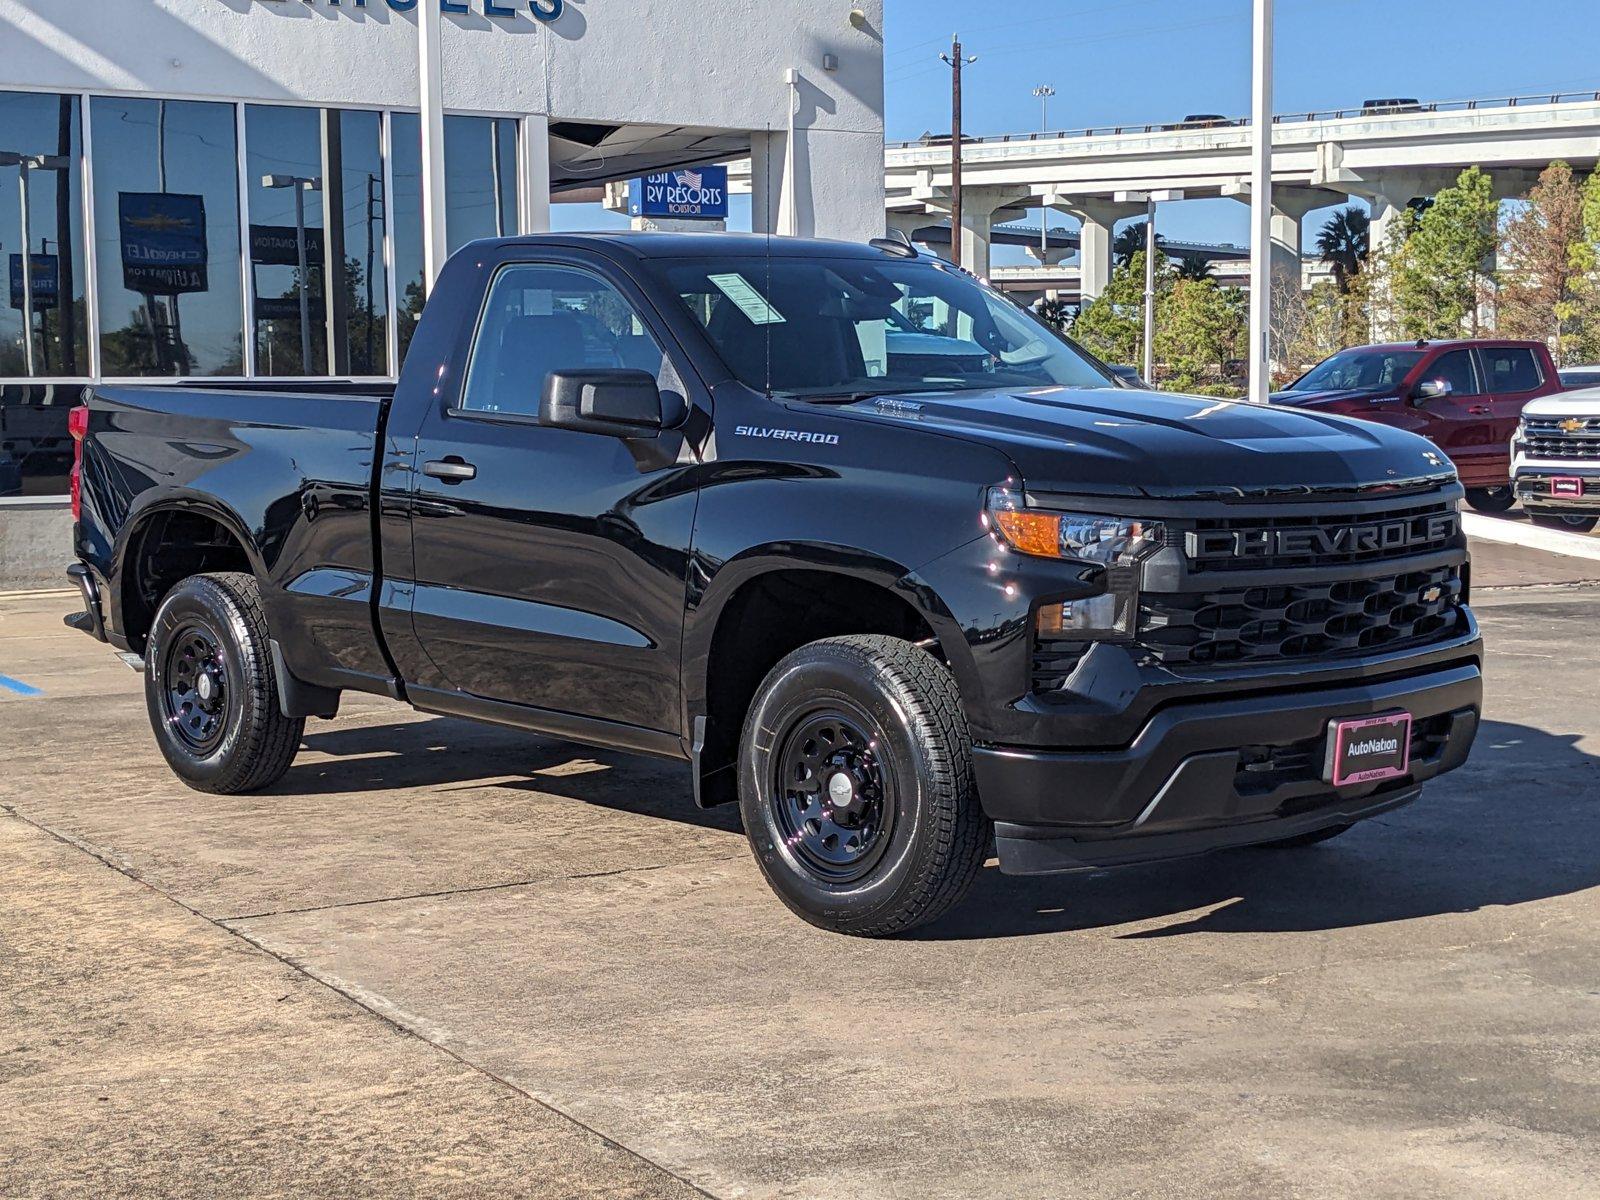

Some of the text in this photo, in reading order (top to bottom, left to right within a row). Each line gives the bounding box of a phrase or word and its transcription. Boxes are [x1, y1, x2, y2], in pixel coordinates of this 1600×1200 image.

[647, 185, 722, 205] RV RESORTS
[668, 203, 702, 214] HOUSTON
[734, 424, 840, 445] SILVERADO
[1184, 514, 1457, 559] CHEVROLET
[1347, 737, 1398, 757] AutoNation
[1357, 769, 1386, 781] AutoNation
